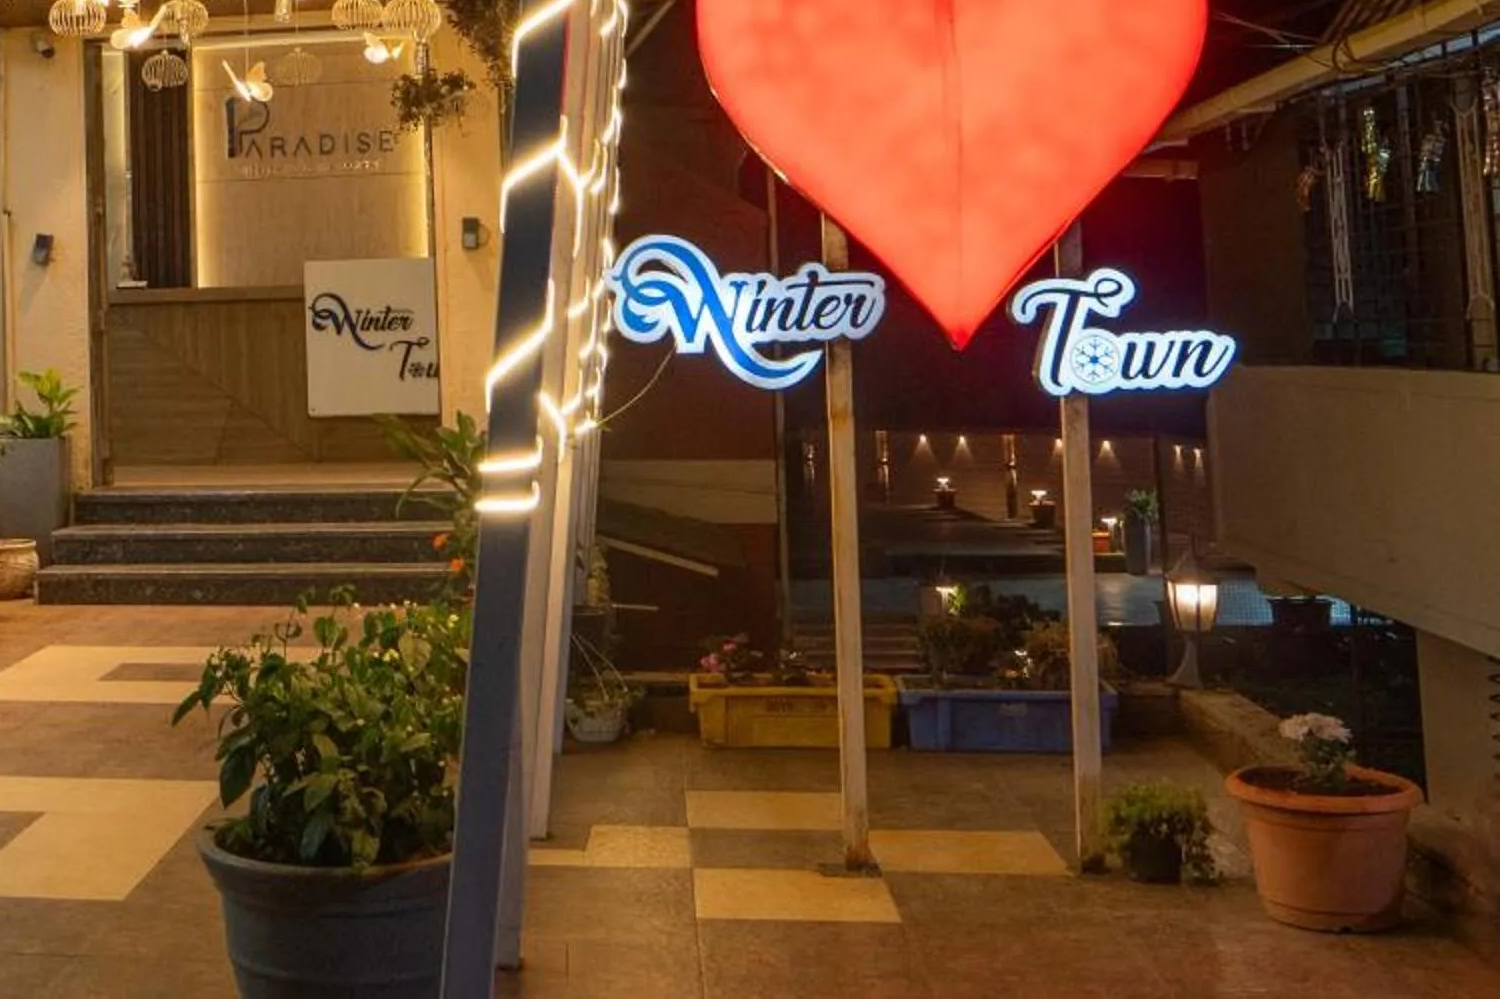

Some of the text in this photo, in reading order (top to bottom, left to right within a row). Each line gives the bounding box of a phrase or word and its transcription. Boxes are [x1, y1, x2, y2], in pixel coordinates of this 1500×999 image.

[308, 292, 414, 351] Winter
[605, 237, 1232, 387] Winter Town
[389, 336, 440, 382] Tow
